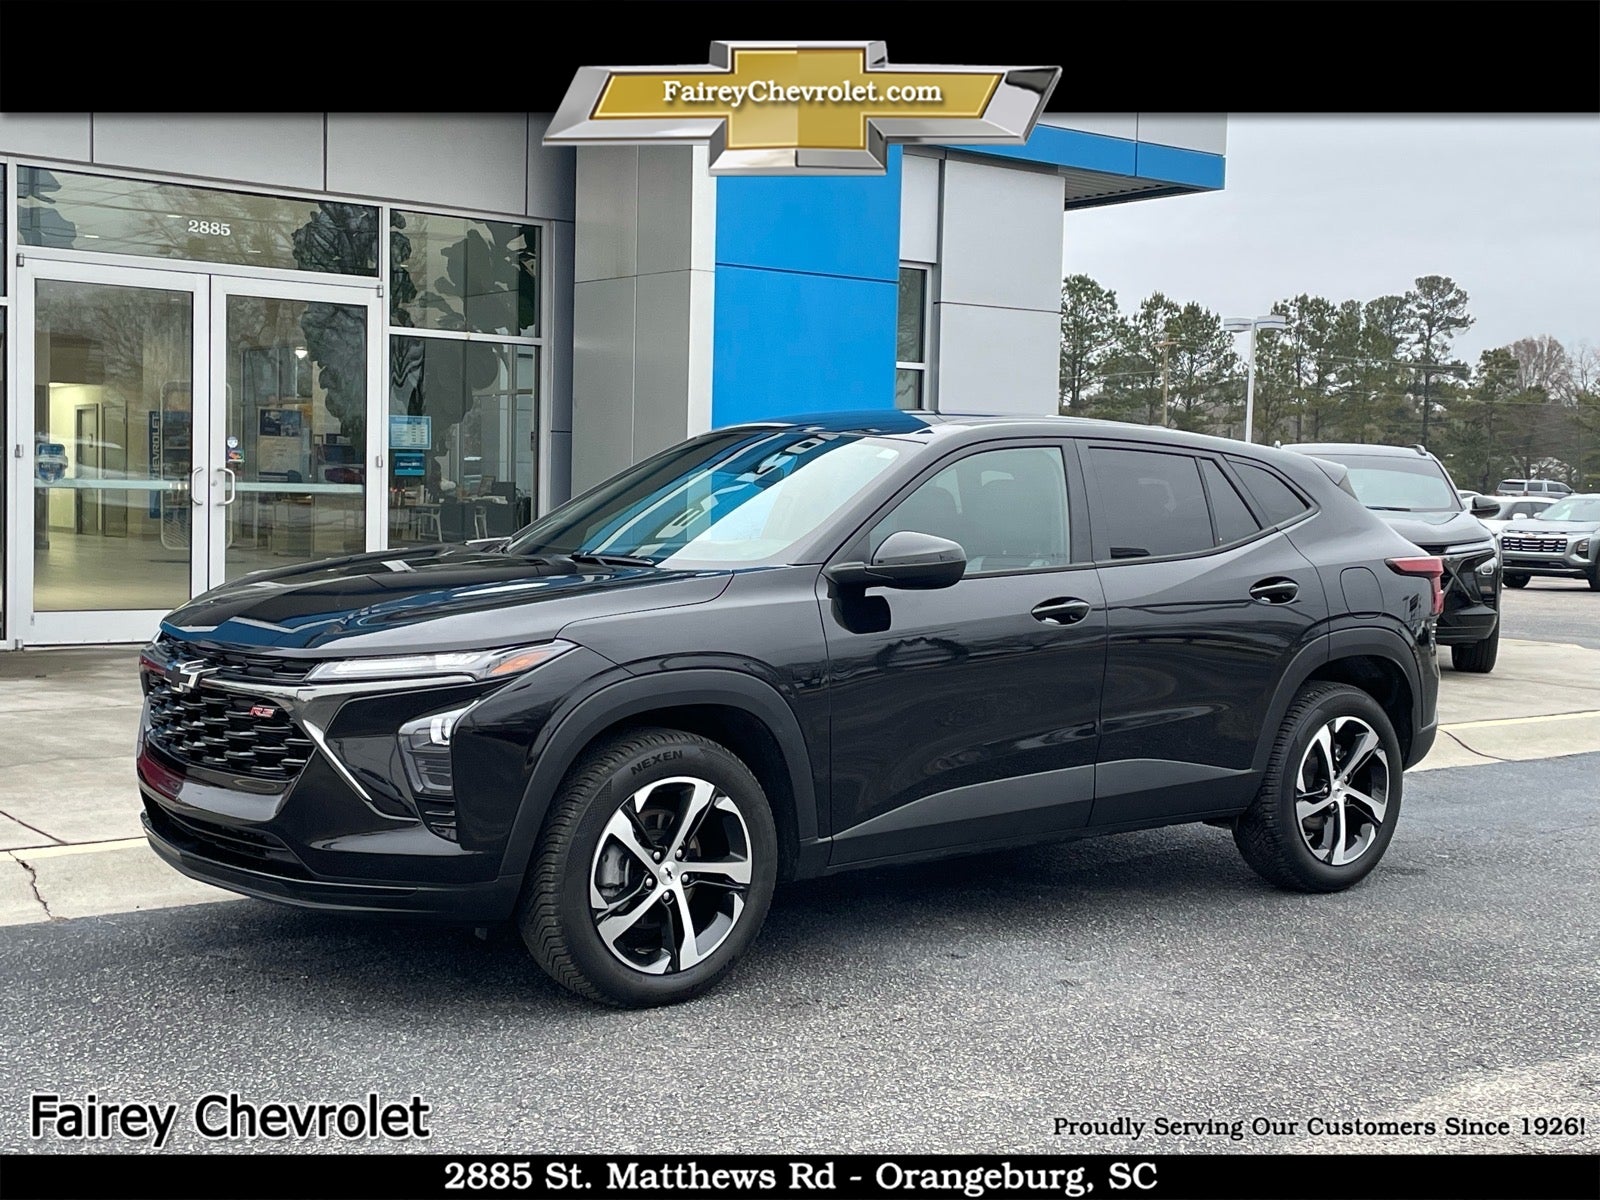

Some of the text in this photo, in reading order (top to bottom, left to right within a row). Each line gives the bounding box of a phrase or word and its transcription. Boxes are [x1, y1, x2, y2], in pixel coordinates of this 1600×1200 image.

[188, 219, 231, 236] 2885
[250, 706, 275, 718] RS
[630, 749, 683, 776] NEXEN
